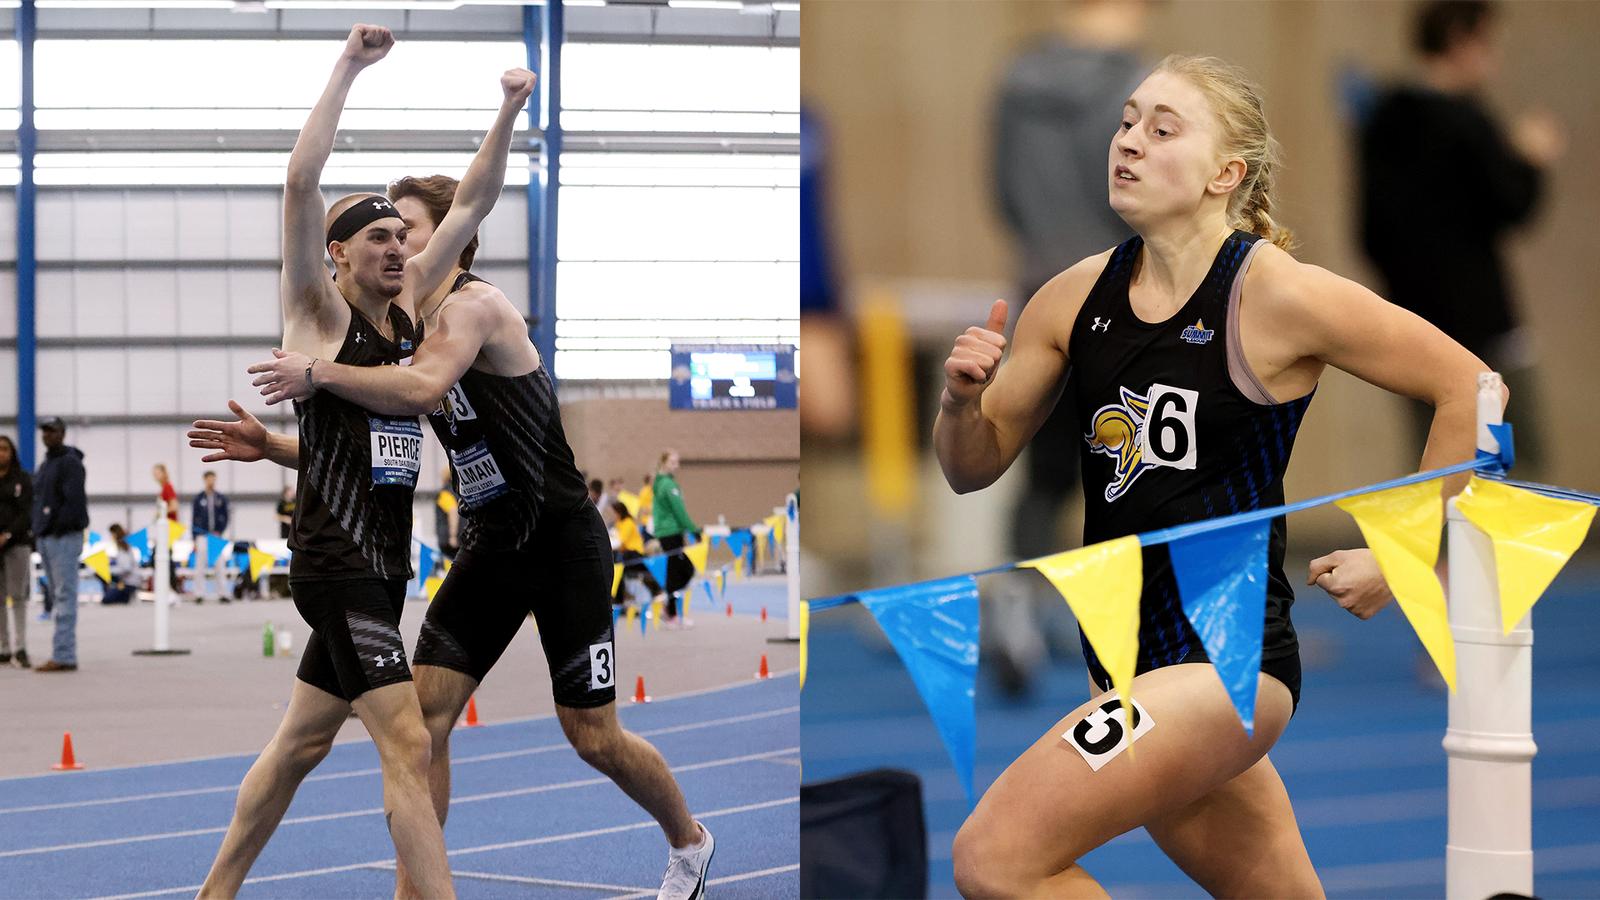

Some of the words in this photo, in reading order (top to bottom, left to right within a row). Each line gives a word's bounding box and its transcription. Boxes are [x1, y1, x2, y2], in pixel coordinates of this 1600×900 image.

[448, 387, 469, 417] 3
[1148, 391, 1188, 462] 6
[378, 435, 420, 461] PIERCE
[460, 458, 497, 486] LMAN
[596, 648, 611, 684] 3
